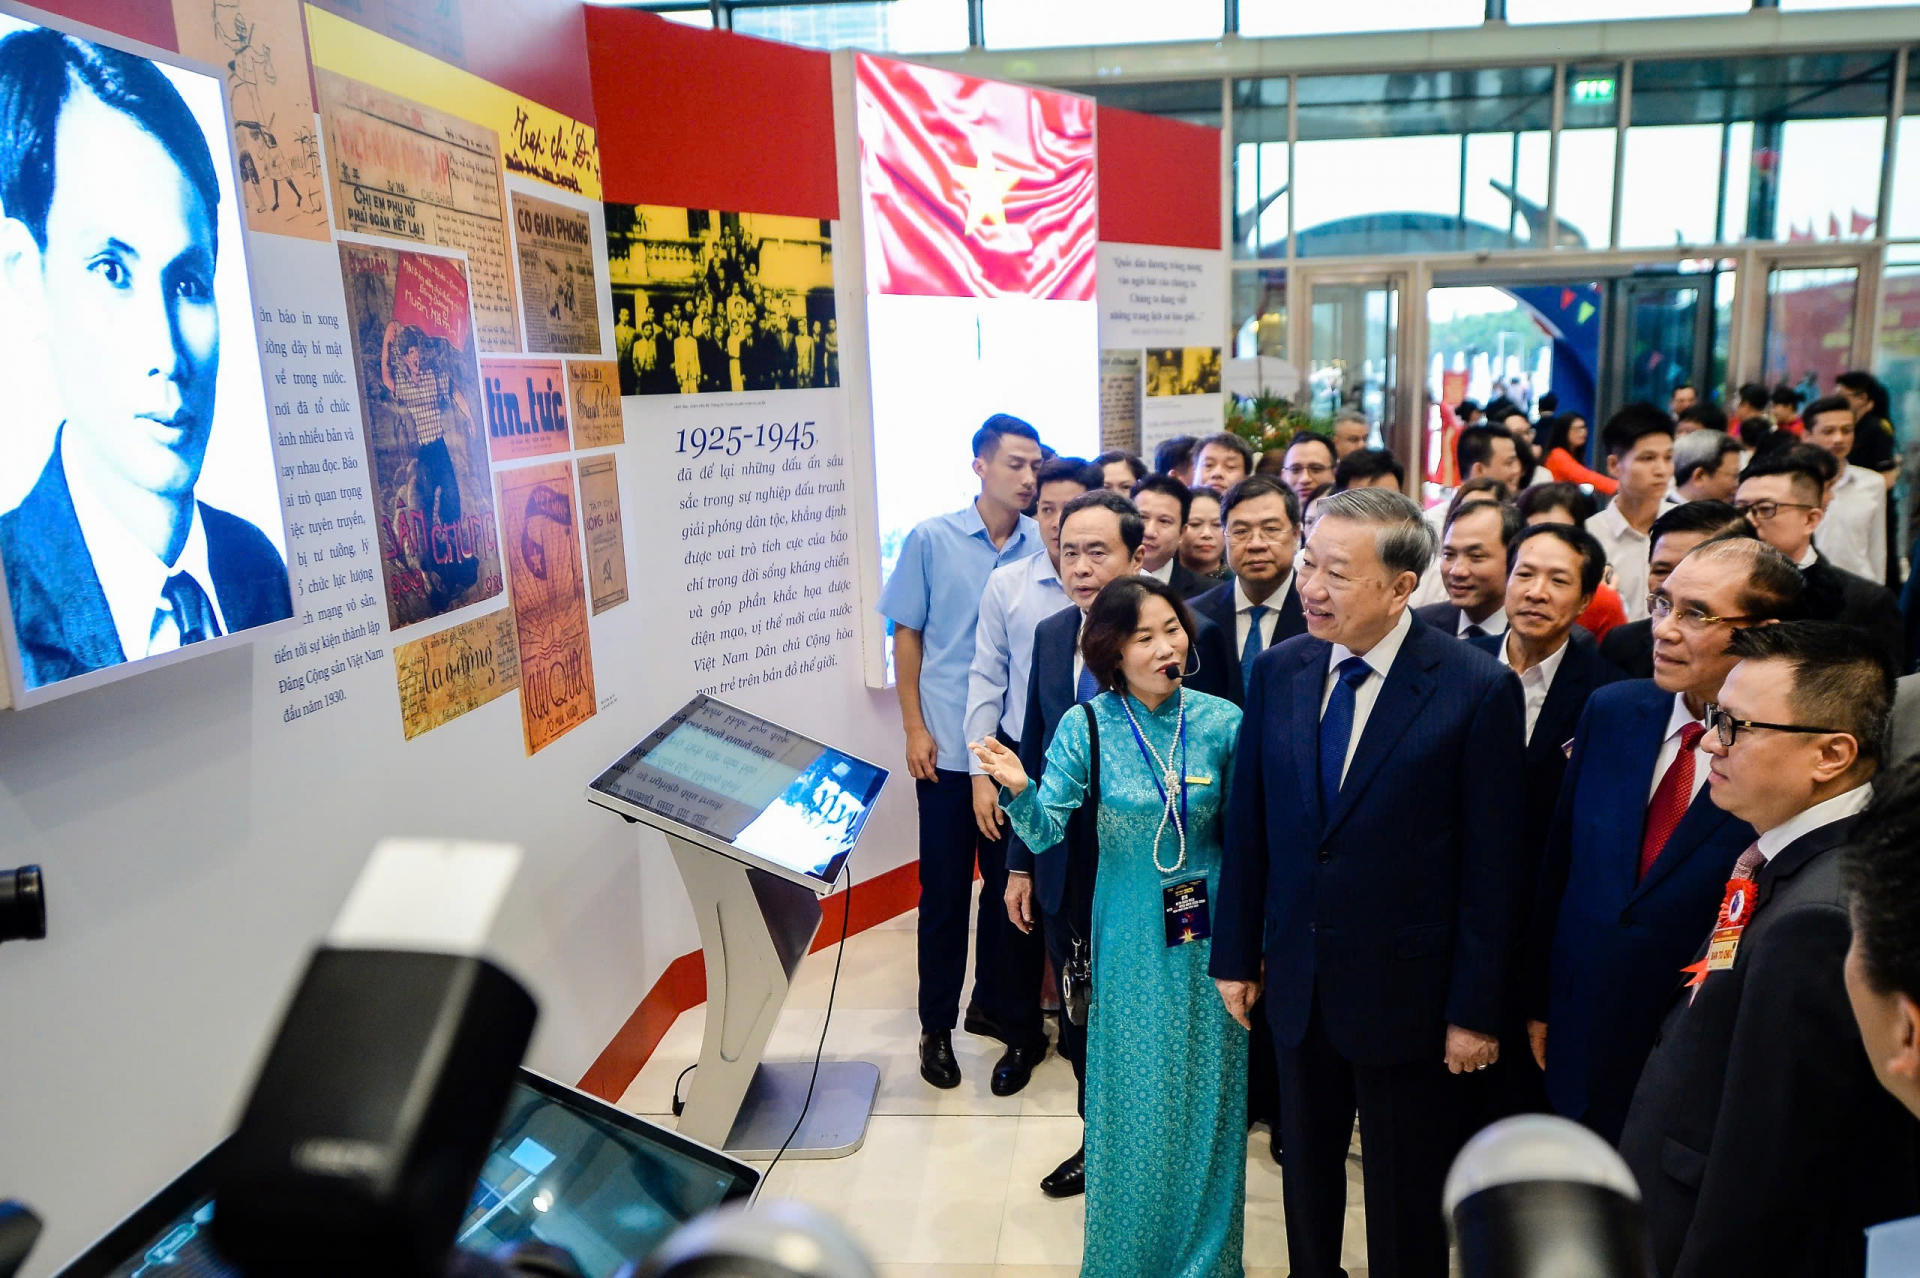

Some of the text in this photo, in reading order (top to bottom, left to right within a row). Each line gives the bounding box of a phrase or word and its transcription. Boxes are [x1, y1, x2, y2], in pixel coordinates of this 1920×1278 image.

[278, 309, 296, 323] báo
[302, 312, 312, 324] in
[318, 316, 339, 329] xong
[292, 340, 307, 357] dây
[312, 341, 321, 354] bí
[326, 342, 342, 357] mật
[275, 368, 286, 384] về
[293, 374, 317, 387] trong
[275, 397, 350, 415] nơi đã tổ chức
[299, 427, 324, 444] nhiều
[326, 428, 342, 442] bản
[344, 428, 354, 440] và
[297, 461, 320, 474] nhau
[322, 459, 340, 474] đọc.
[342, 456, 358, 469] Báo
[677, 454, 843, 481] đã để lại những dấu ấn sâu
[286, 487, 362, 507] ai trò quan trọng
[680, 479, 844, 509] sắc trong sự nghiệp đấu tranh
[290, 523, 304, 539] iệc
[309, 518, 333, 535] tuyên
[682, 504, 846, 540] giải phóng dân tộc, khẳng định
[314, 549, 323, 562] tư
[361, 538, 369, 554] lý
[685, 530, 848, 565] được vai trò tích cực của báo
[308, 577, 329, 593] chức
[333, 574, 346, 588] lực
[350, 568, 373, 586] lượng
[687, 552, 849, 592] chí trong đời sống kháng chiến
[318, 606, 343, 620] mạng
[346, 598, 356, 611] vô
[690, 580, 851, 619] và góp phần khắc họa được
[691, 603, 852, 646] diện mạo, vị thế mới của nước
[274, 621, 380, 664] tiến tới sự kiện thành lập
[694, 628, 853, 672] Việt Nam Dân chủ Cộng hòa
[279, 649, 384, 693] Đảng Cộng sản Việt Nam
[720, 676, 735, 693] trẻ
[739, 674, 759, 688] trên
[763, 667, 782, 682] bản
[785, 661, 797, 677] đồ
[800, 656, 816, 673] thế
[817, 655, 837, 672] giới.
[284, 689, 346, 722] đầu năm 1930.
